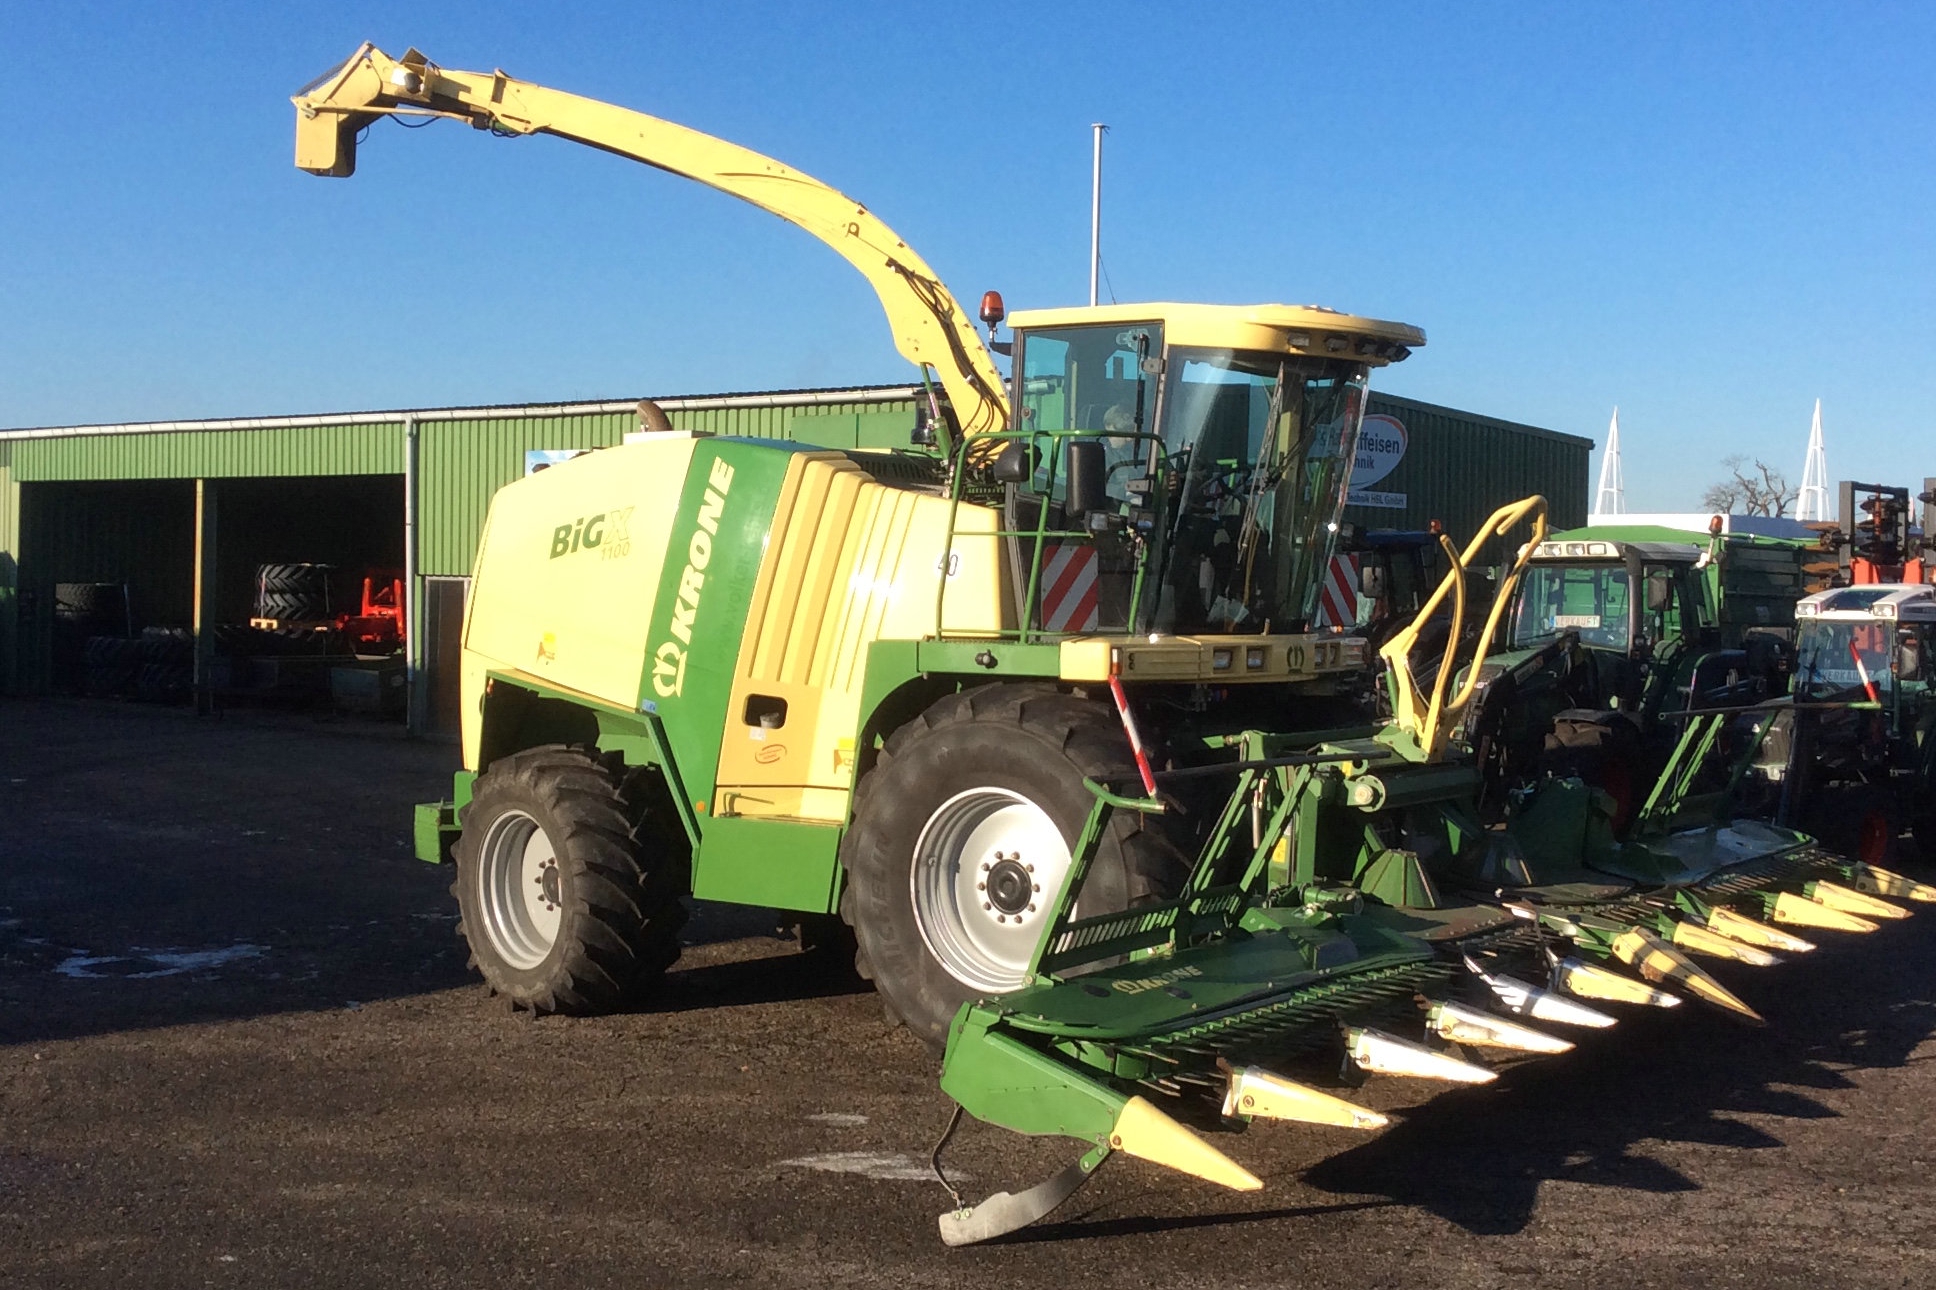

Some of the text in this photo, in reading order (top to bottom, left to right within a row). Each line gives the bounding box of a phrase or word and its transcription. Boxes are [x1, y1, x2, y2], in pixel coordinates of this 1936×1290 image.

[601, 541, 630, 561] 1100
[670, 456, 735, 645] KRONE
[1136, 965, 1203, 989] KRONE
